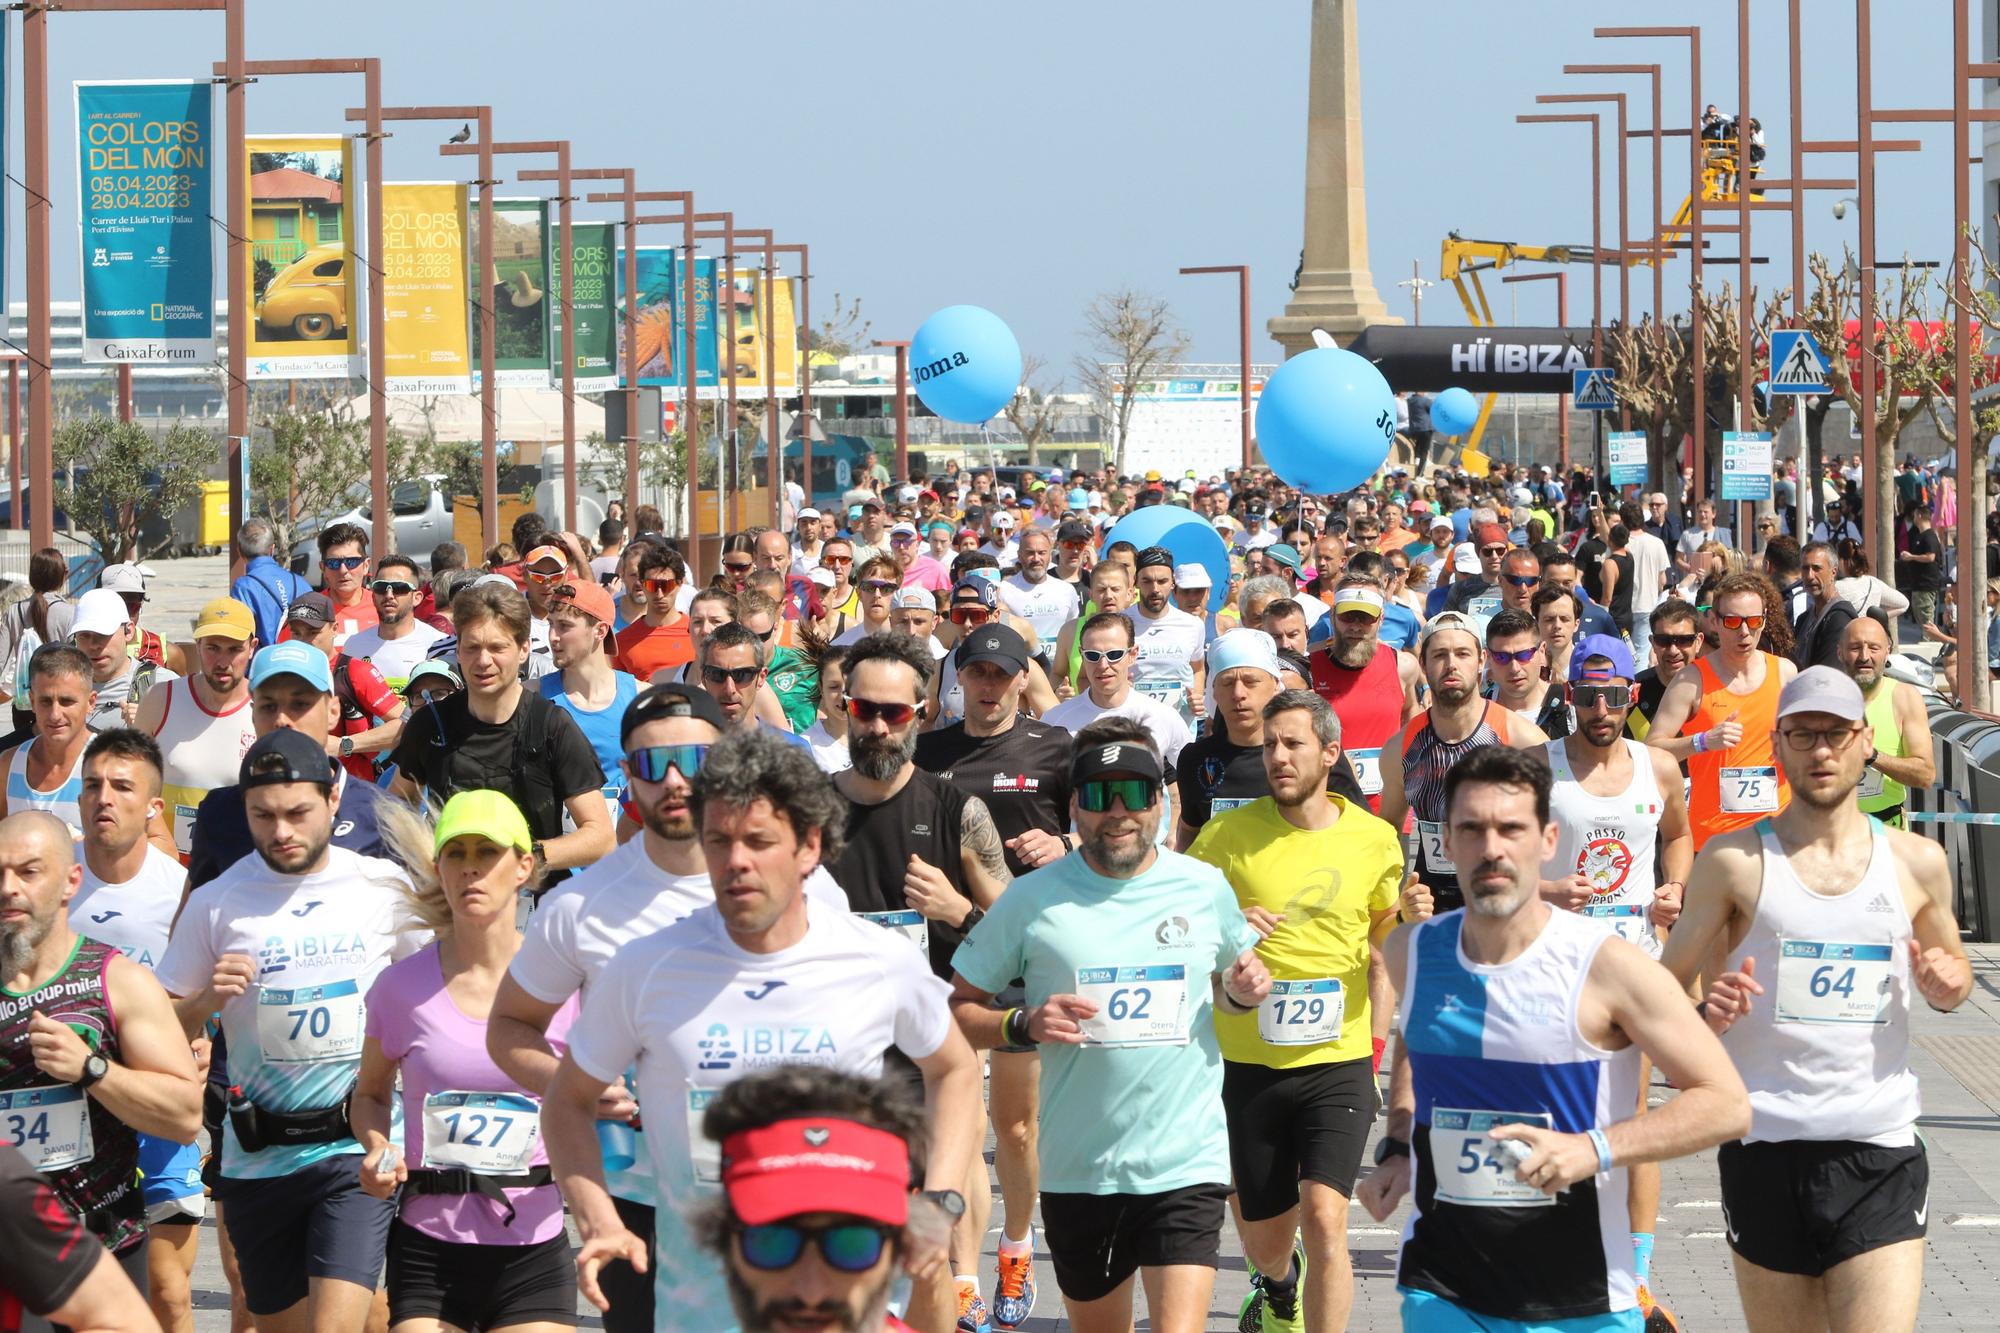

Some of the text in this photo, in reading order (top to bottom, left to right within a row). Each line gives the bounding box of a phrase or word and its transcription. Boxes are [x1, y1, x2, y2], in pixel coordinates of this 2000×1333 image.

[88, 121, 199, 145] COLORS
[89, 144, 204, 170] DEL MÓN
[90, 175, 197, 192] 05.04.2023-
[91, 192, 190, 209] 29.04.2023
[91, 217, 116, 225] Carrer
[118, 216, 129, 224] de
[151, 216, 165, 224] Tur
[385, 266, 450, 278] 9.04.2023
[574, 261, 610, 276] MÓN
[104, 344, 195, 359] CaixaForum
[1495, 344, 1588, 373] IBIZA
[274, 362, 312, 371] Fundació
[914, 352, 969, 384] Joma
[1149, 645, 1183, 654] IBIZA
[1737, 780, 1760, 798] 75
[1586, 827, 1626, 841] PASSO
[1865, 905, 1894, 913] adidas
[294, 933, 366, 957] IBIZA
[295, 953, 367, 969] MARATHON
[1810, 965, 1856, 999] 64
[18, 984, 64, 1012] group
[1108, 987, 1152, 1020] 62
[1273, 998, 1324, 1024] 129
[288, 1007, 331, 1041] 70
[743, 1028, 837, 1054] IBIZA
[7, 1111, 50, 1148] 34
[444, 1112, 514, 1147] 127
[44, 1142, 77, 1155] DAVIDE
